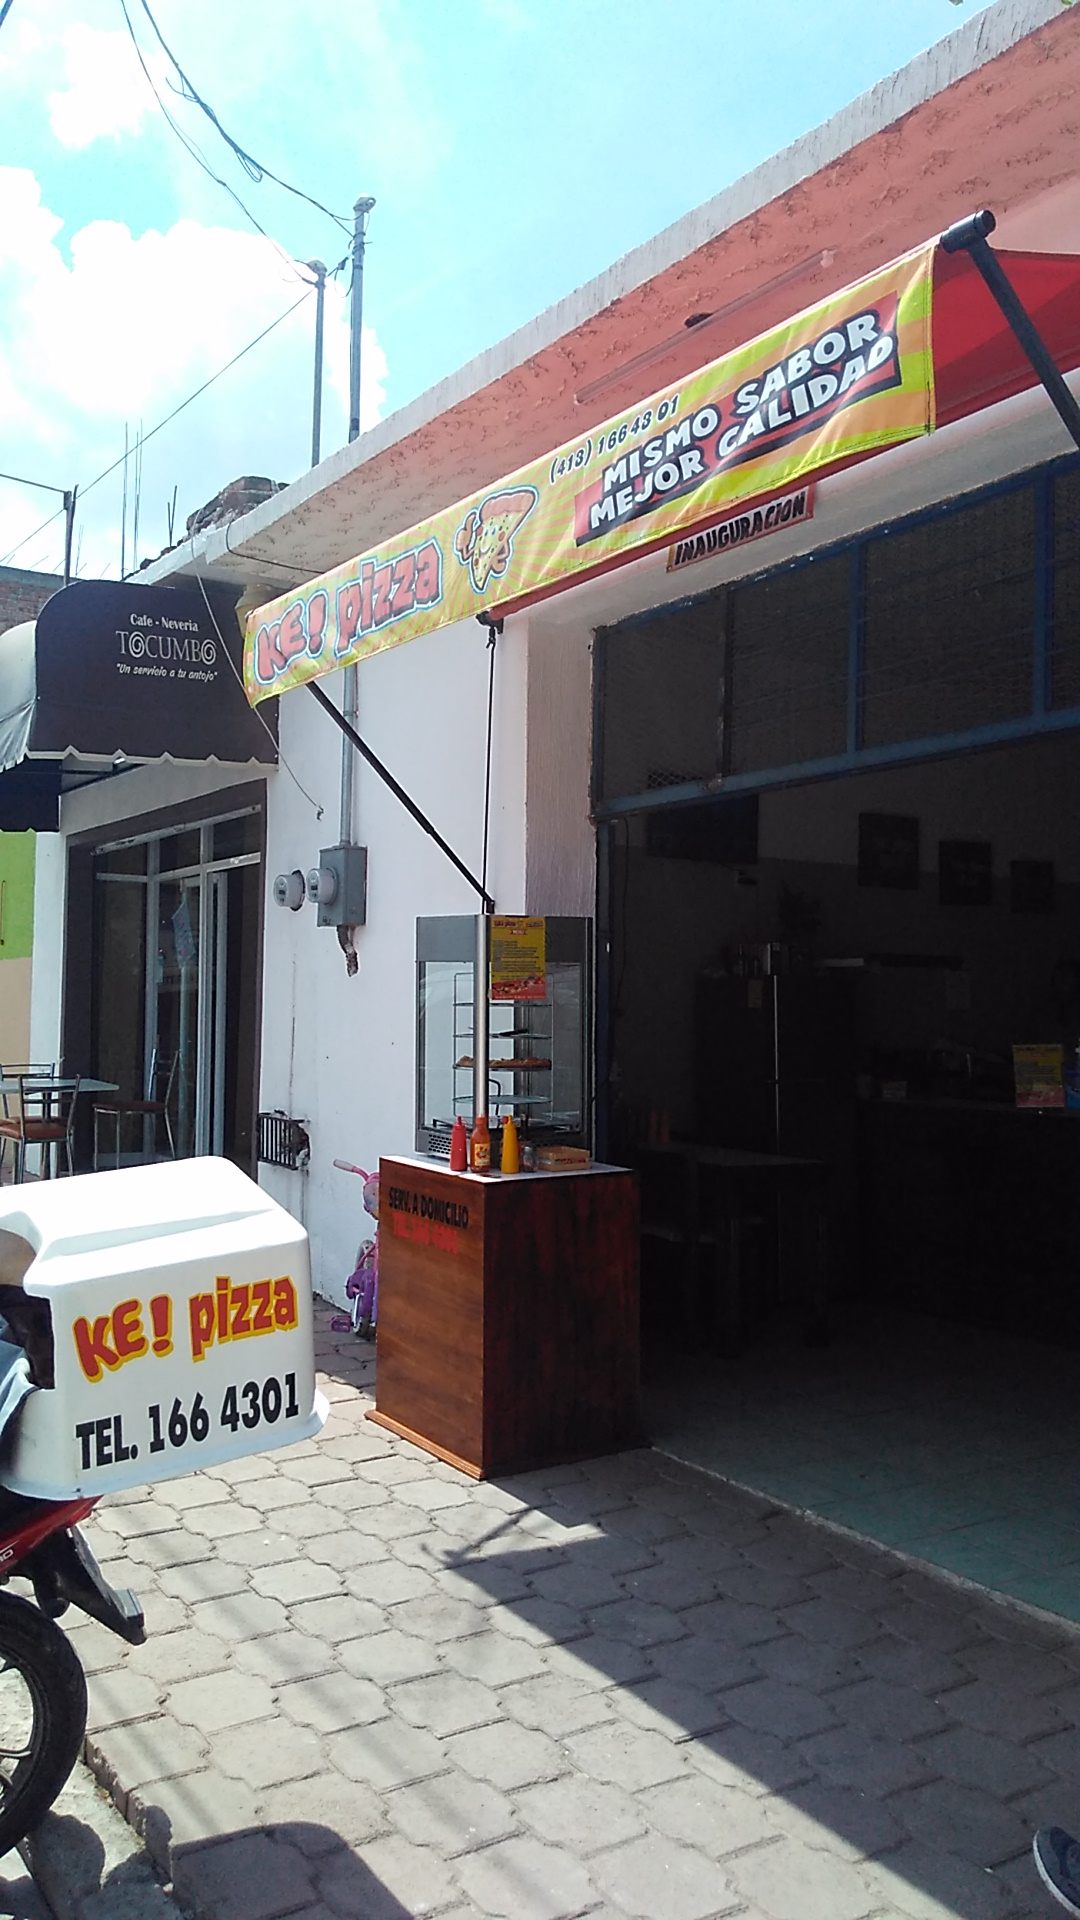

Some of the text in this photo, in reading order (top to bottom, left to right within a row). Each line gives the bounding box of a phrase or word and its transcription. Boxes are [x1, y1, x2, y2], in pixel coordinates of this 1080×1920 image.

[589, 334, 894, 530] MEJOR CALIDAD
[602, 313, 881, 493] MISMO SABOR
[550, 439, 592, 484] (413)
[130, 613, 153, 627] Cafe
[255, 540, 442, 682] KE! pizza
[115, 630, 217, 665] TOCUMBO
[133, 665, 168, 677] servicio
[169, 669, 176, 677] a
[177, 668, 187, 678] tu
[411, 1192, 420, 1216] A
[420, 1194, 470, 1230] DOMICILIO
[72, 1275, 299, 1384] KE! pizza
[75, 1371, 300, 1471] TEL. 166 4301
